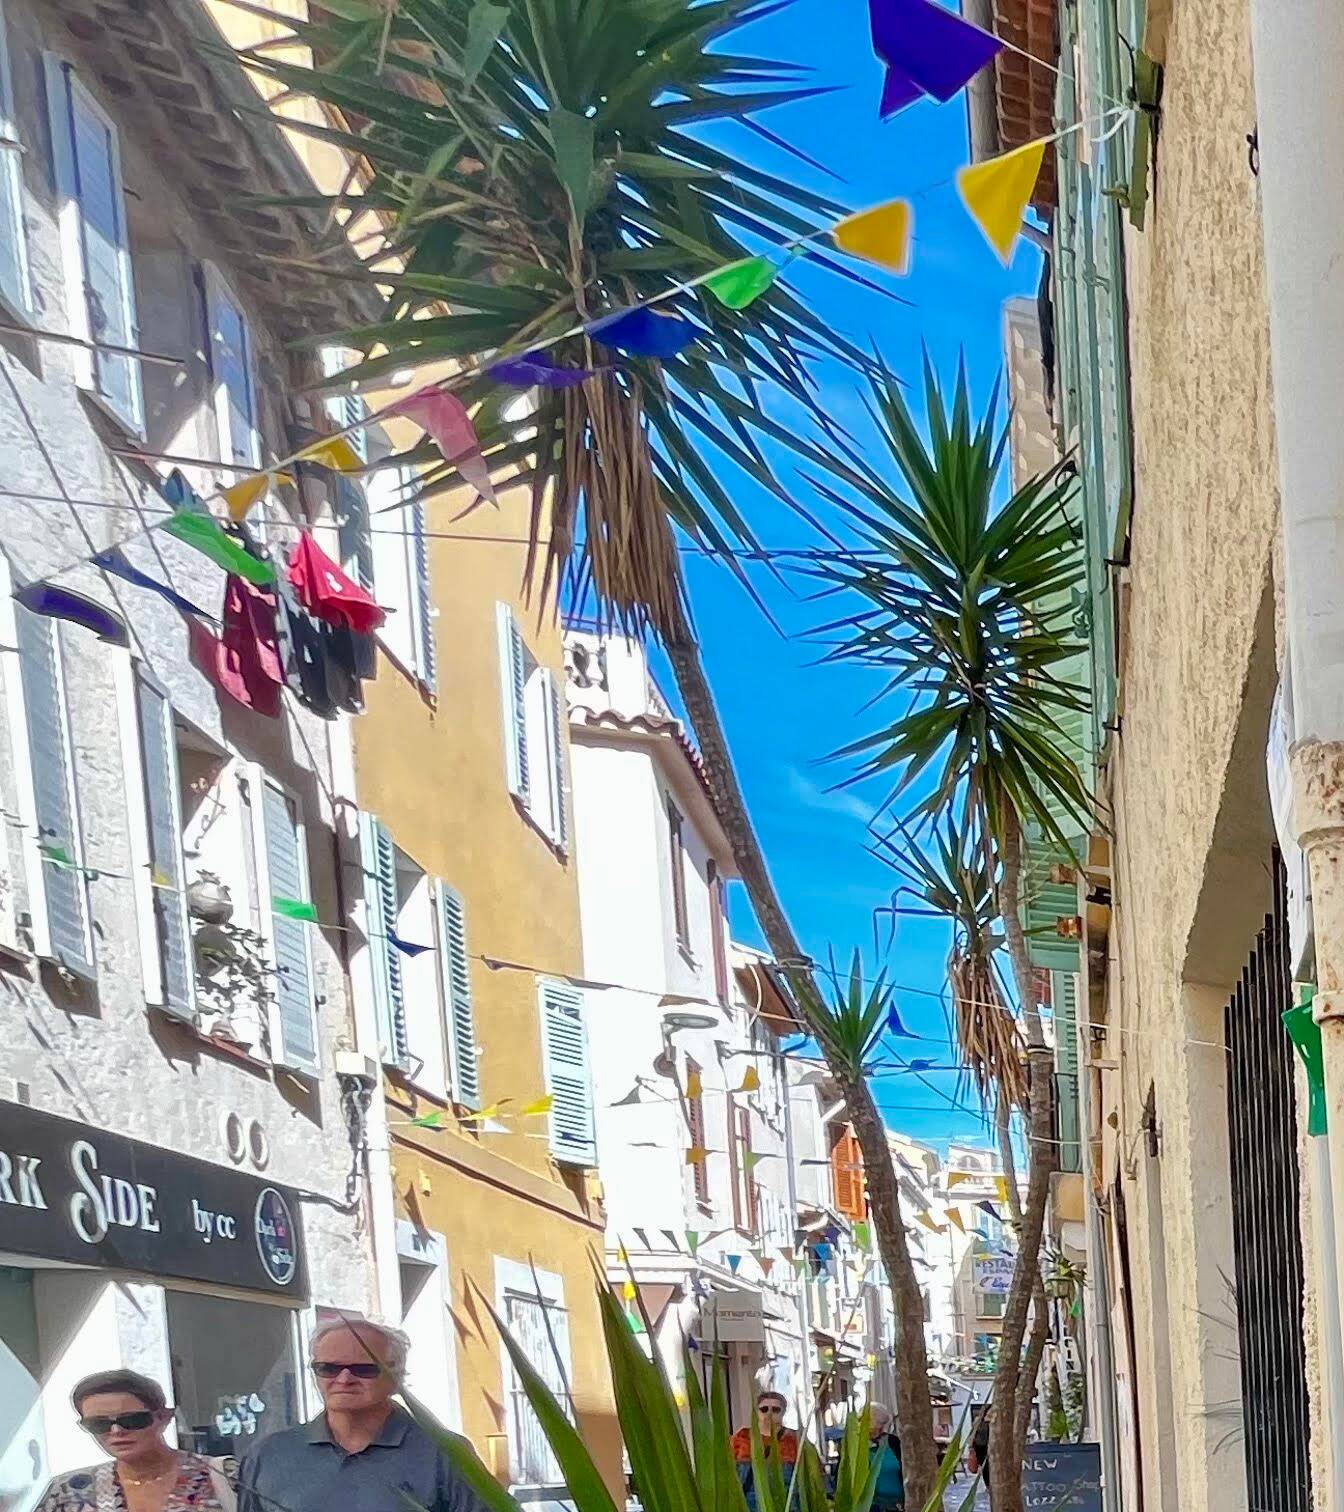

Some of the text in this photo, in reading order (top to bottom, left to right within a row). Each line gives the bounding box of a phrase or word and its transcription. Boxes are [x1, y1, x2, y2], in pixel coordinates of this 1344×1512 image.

[70, 1139, 161, 1244] SIDE
[191, 1199, 215, 1244] by
[1021, 1458, 1058, 1472] NEW
